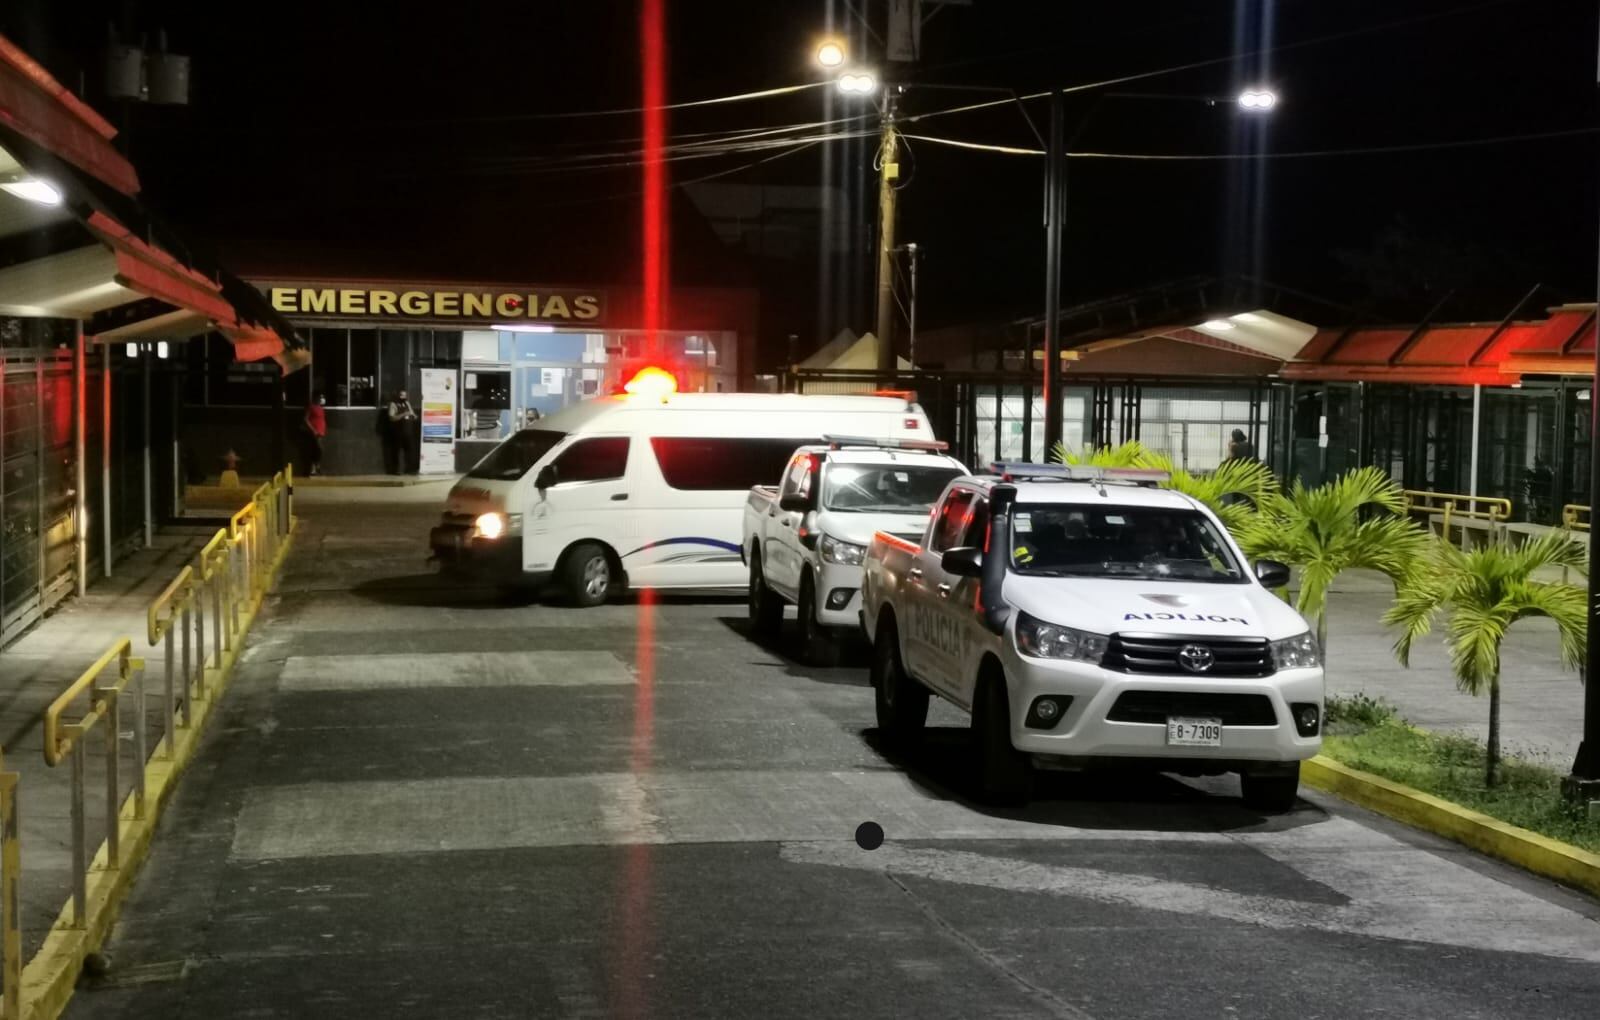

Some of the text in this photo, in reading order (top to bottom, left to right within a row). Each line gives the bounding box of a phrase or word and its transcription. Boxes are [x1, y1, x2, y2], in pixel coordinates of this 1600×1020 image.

[272, 287, 599, 318] EMERGENCIAS
[914, 604, 961, 657] POLICIA
[1177, 724, 1219, 739] 8-7309
